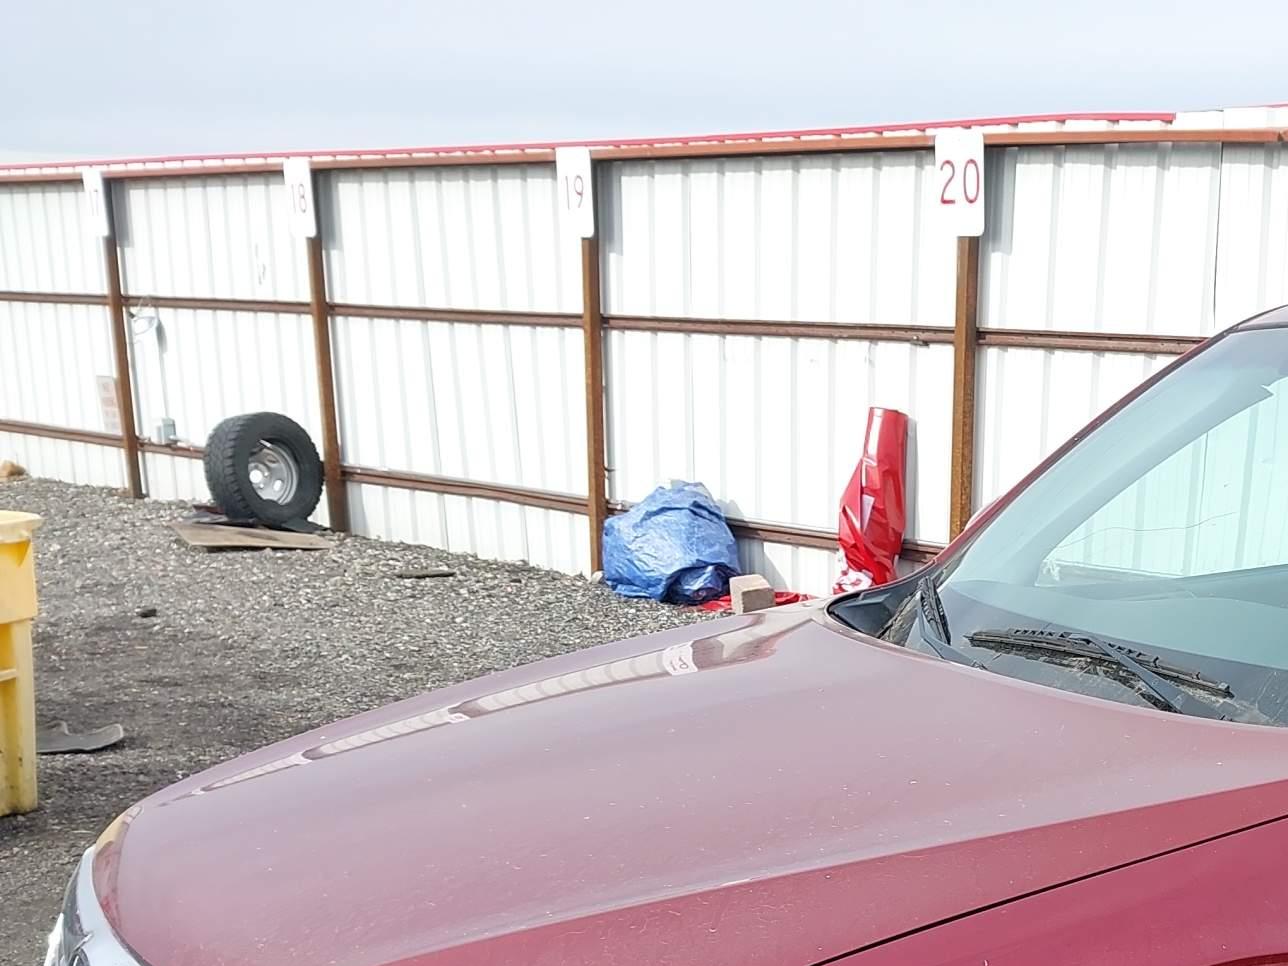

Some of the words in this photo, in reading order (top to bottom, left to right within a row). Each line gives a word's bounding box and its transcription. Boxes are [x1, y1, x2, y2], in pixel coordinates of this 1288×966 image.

[288, 183, 307, 213] 18
[565, 174, 584, 210] 19
[940, 159, 980, 204] 20
